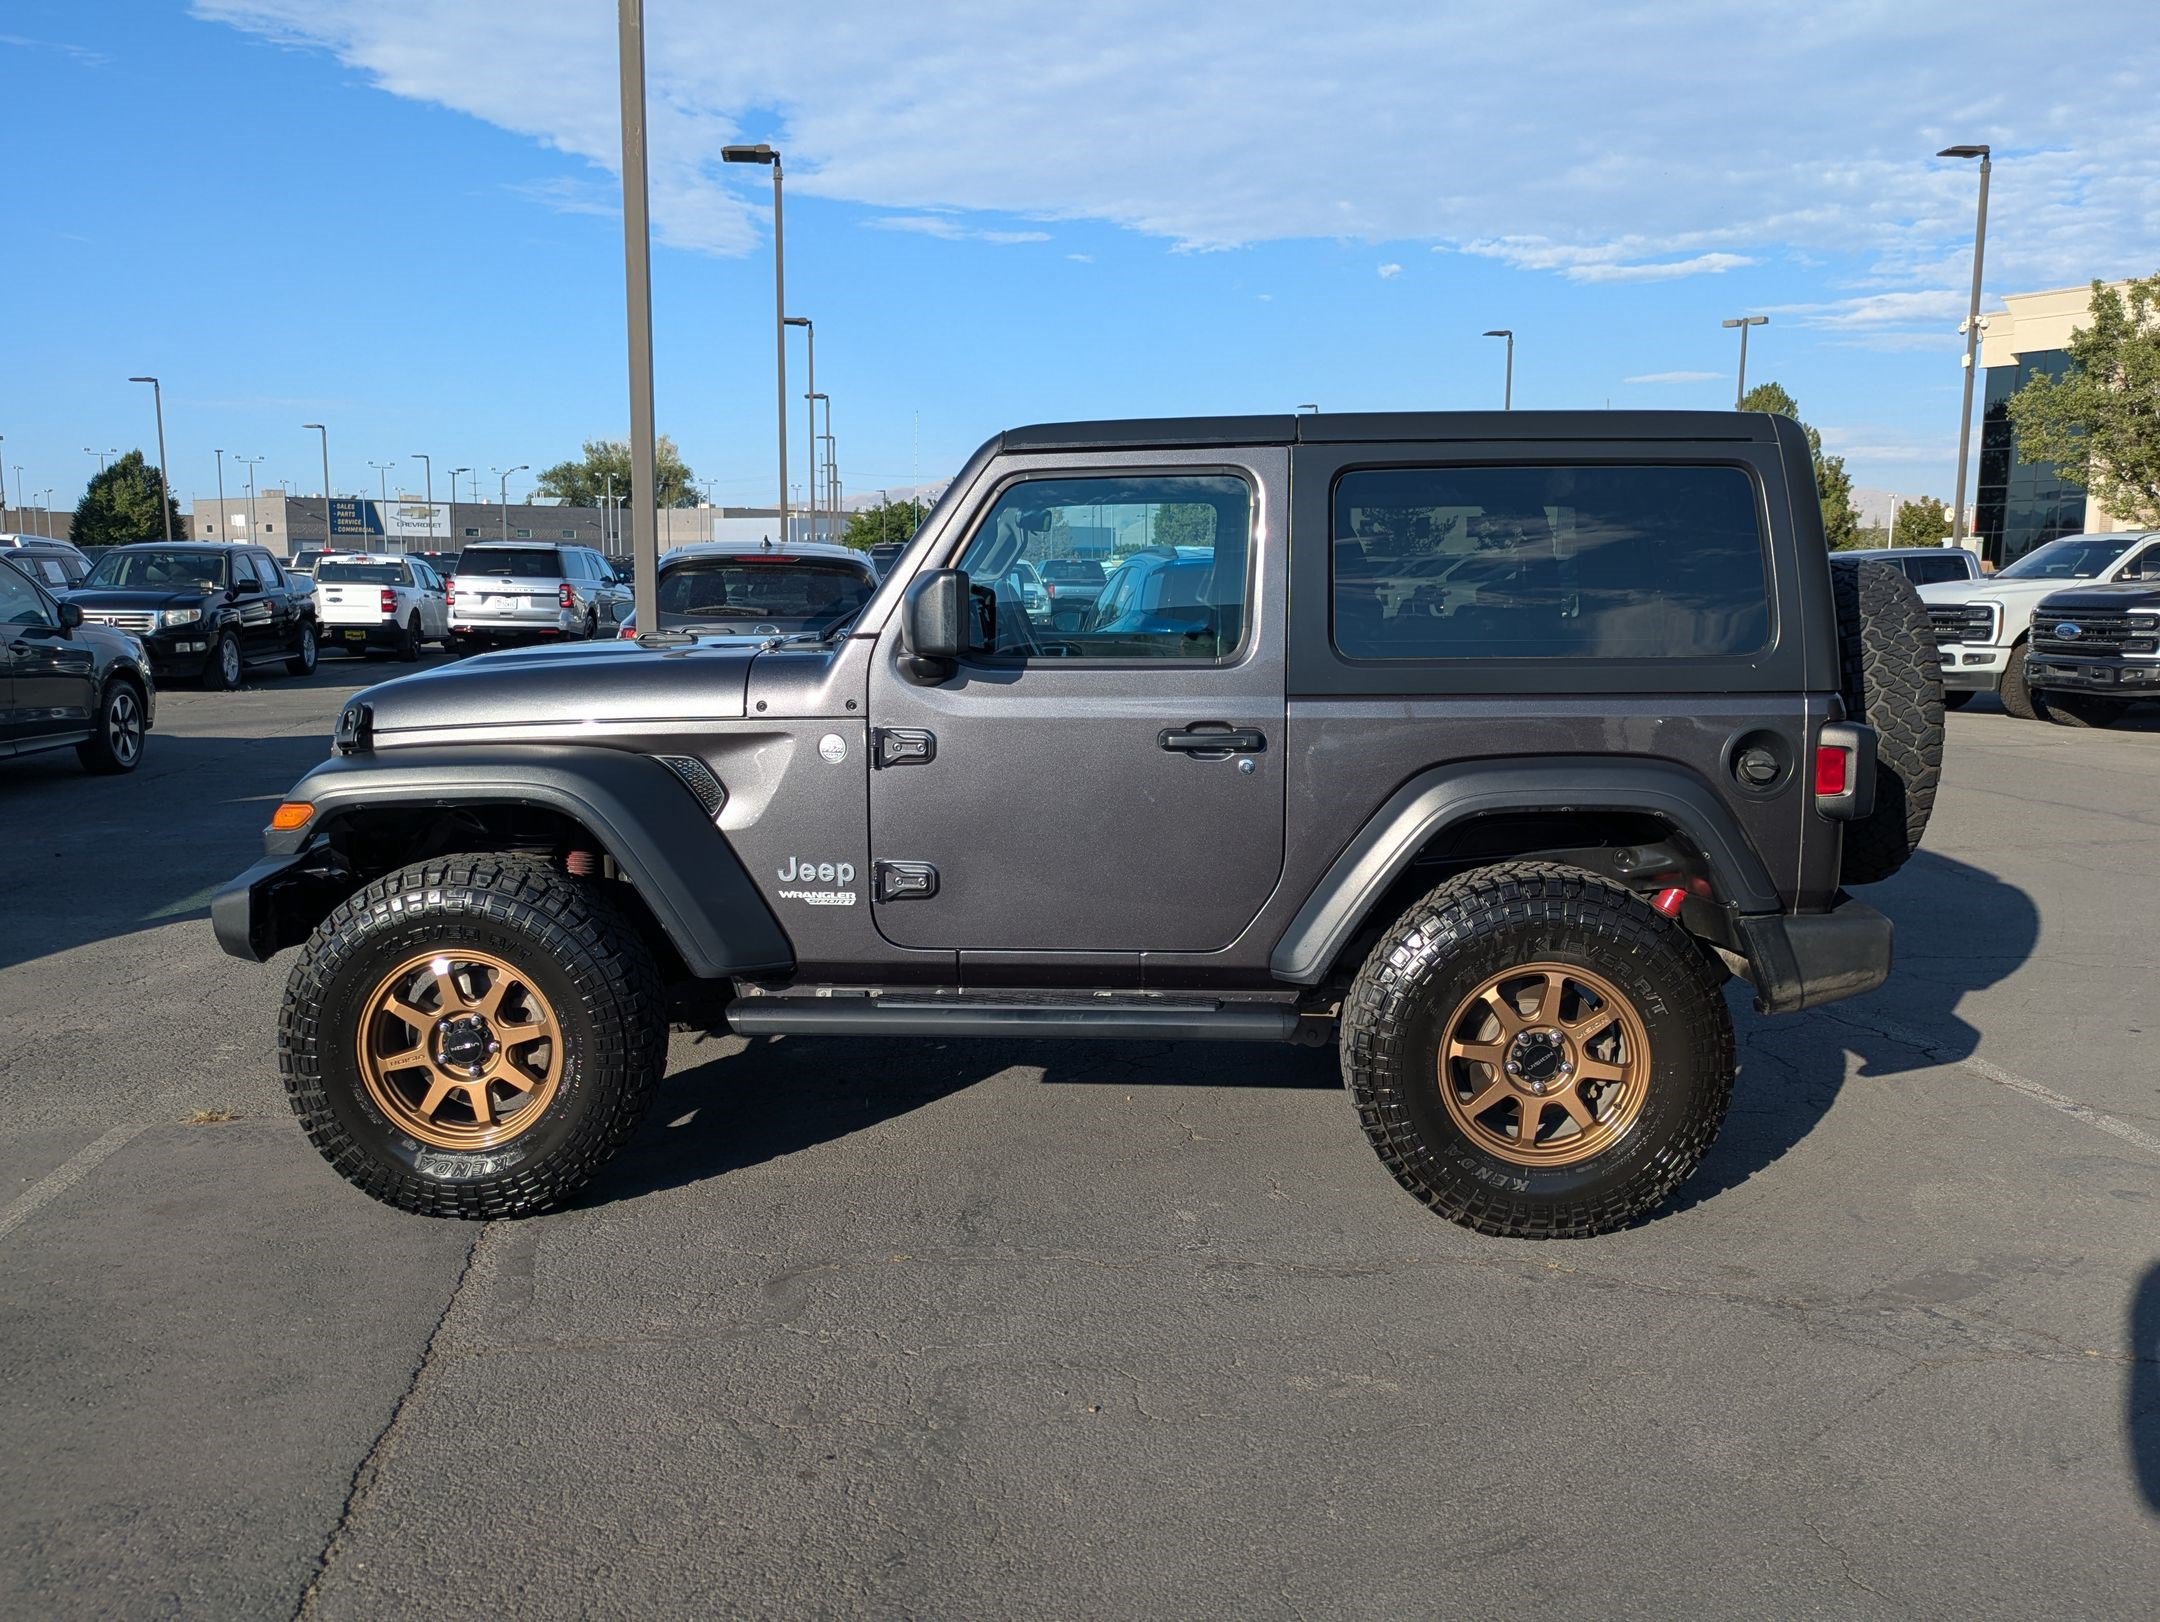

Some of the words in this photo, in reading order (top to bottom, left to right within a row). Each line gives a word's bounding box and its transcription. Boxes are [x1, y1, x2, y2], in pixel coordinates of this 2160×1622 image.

[777, 856, 856, 887] Jeep
[778, 890, 856, 899] WRANGLER
[376, 924, 481, 959] KLEVER
[1527, 1050, 1554, 1071] VISION
[417, 1155, 508, 1178] KENDA
[1444, 1142, 1531, 1193] KENDA
